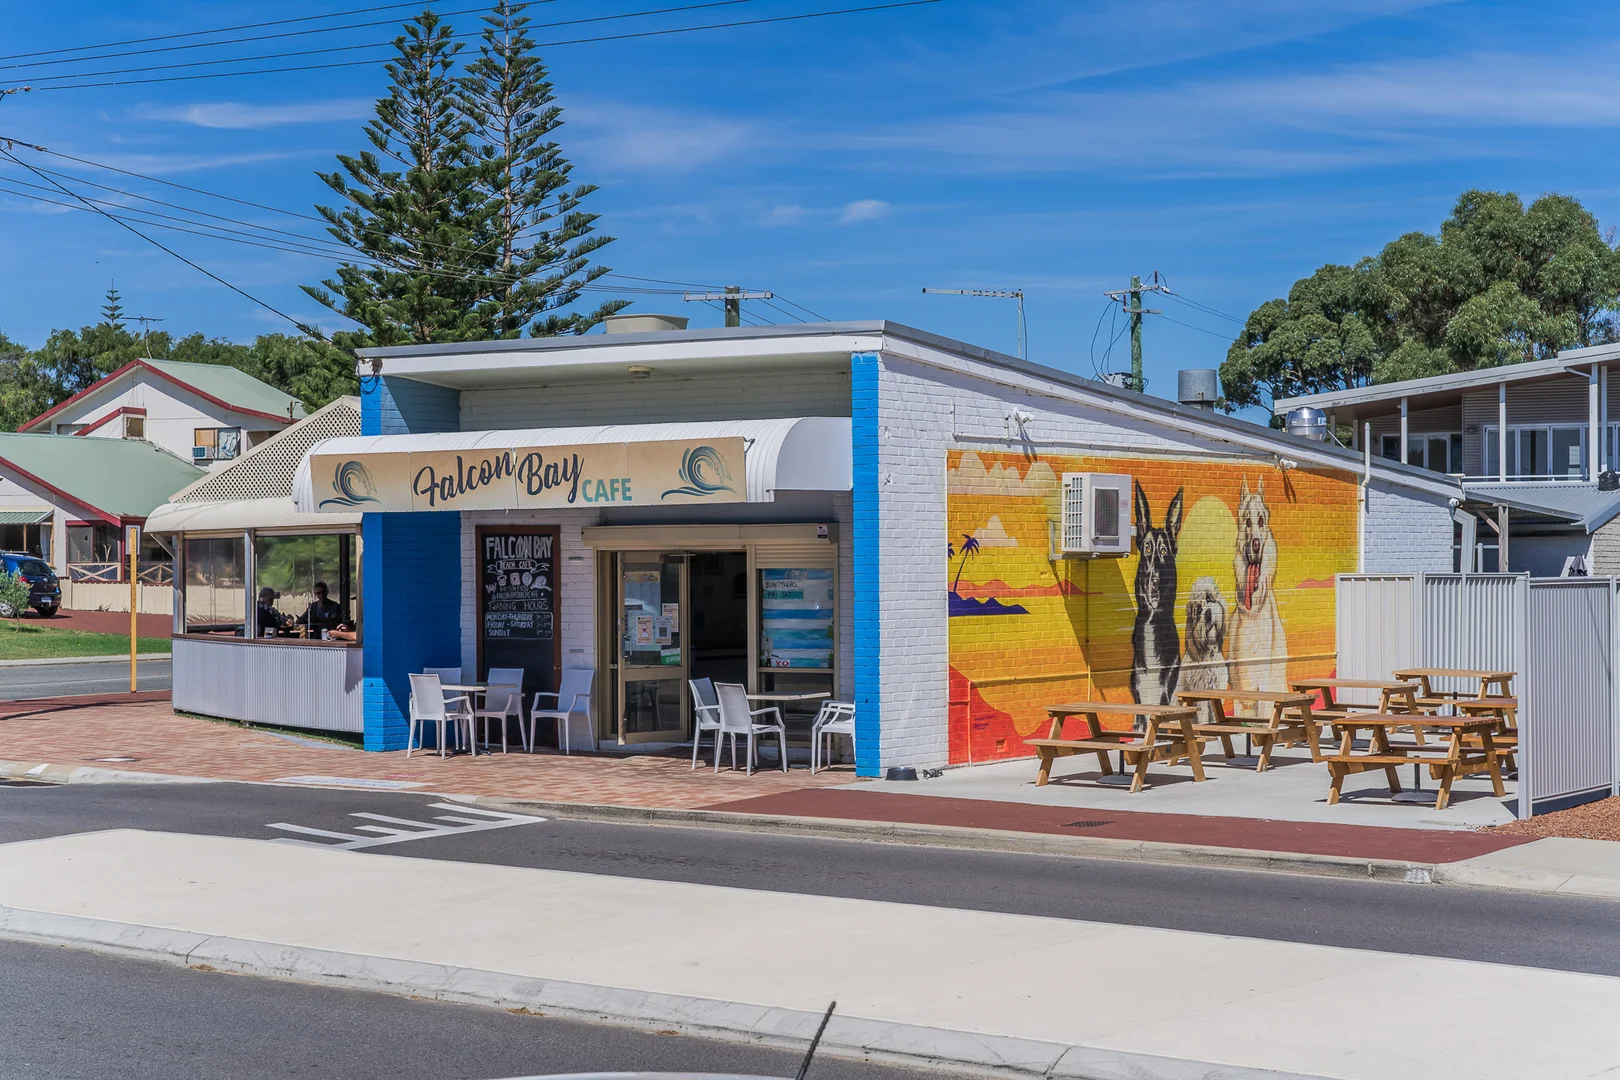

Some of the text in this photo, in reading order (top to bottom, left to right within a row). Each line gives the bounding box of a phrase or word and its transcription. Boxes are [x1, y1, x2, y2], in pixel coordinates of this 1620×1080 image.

[413, 451, 633, 507] Falcon Bay CAFE
[485, 535, 554, 560] FALCON BAY
[499, 560, 533, 569] BEACH CAFE
[487, 600, 549, 611] TRADING HOURS
[488, 628, 511, 637] SUNDAY
